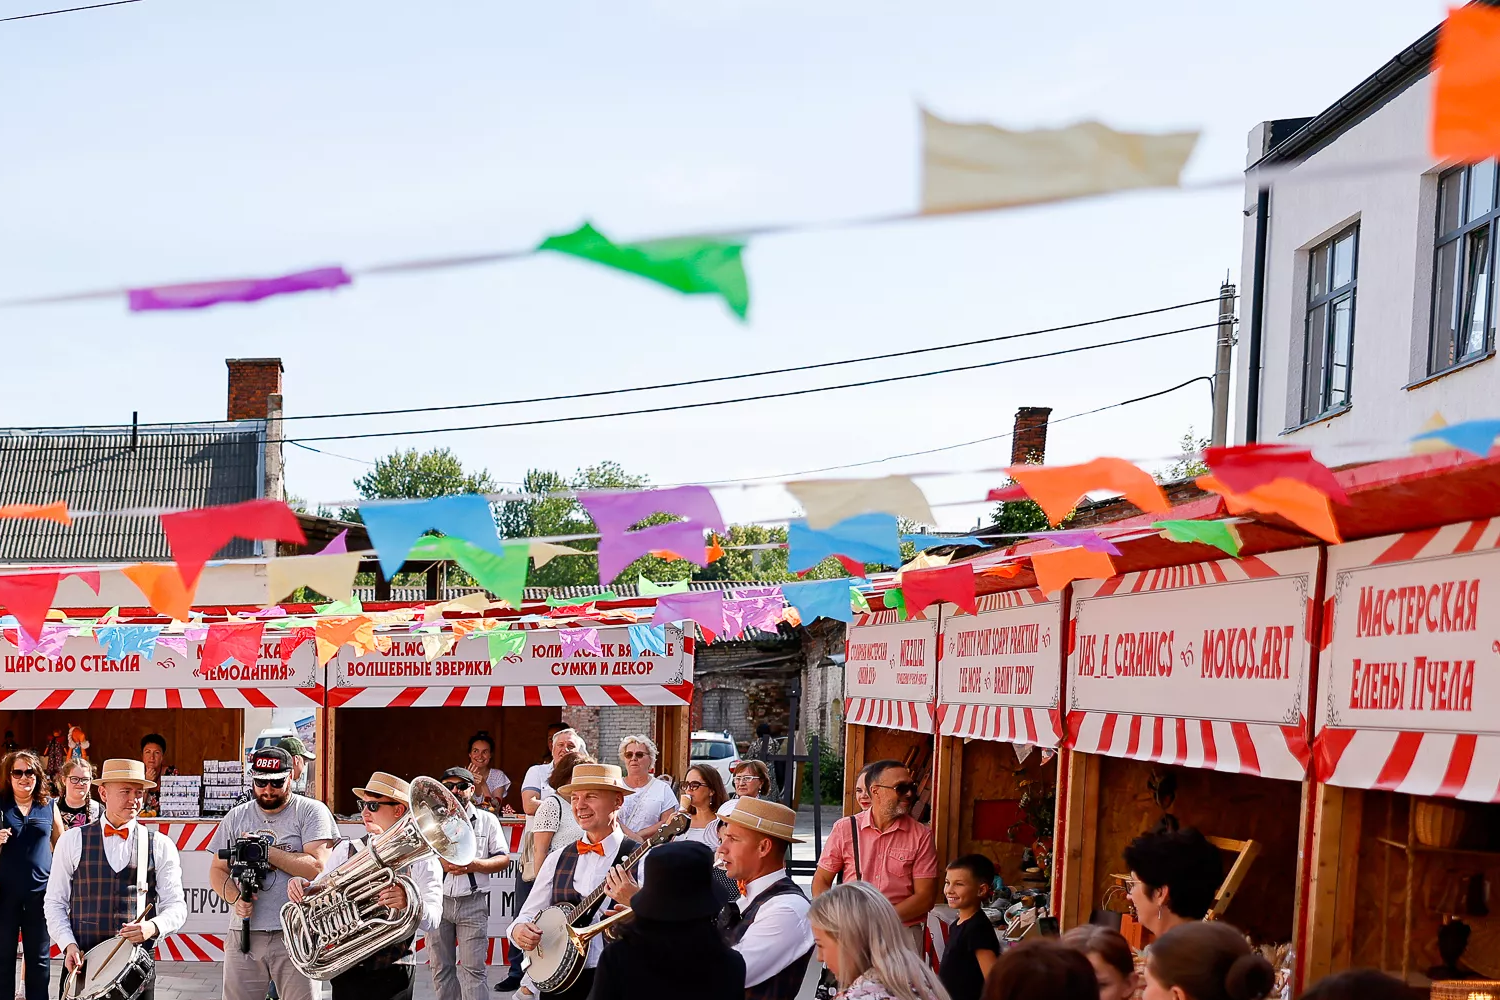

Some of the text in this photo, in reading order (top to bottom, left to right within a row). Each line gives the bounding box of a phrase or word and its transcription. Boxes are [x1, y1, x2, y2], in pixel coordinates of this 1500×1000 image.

[1356, 578, 1480, 637] МАСТЕРСКАЯ
[532, 644, 570, 658] ЮЛИ
[1078, 630, 1175, 678] VAS_A_CERAMICS
[1201, 625, 1294, 680] MOKOS.ART
[5, 654, 140, 673] ЦАРСТВО СТЕКЛА
[347, 661, 493, 676] ВОЛШЕБНЫЕ ЗВЕРИКИ
[551, 661, 654, 676] СУМКИ И ДЕКОР
[1014, 665, 1035, 694] TEDDY
[1348, 655, 1476, 712] ЕЛЕНЫ ПЧЕЛА
[256, 758, 279, 769] OBEY
